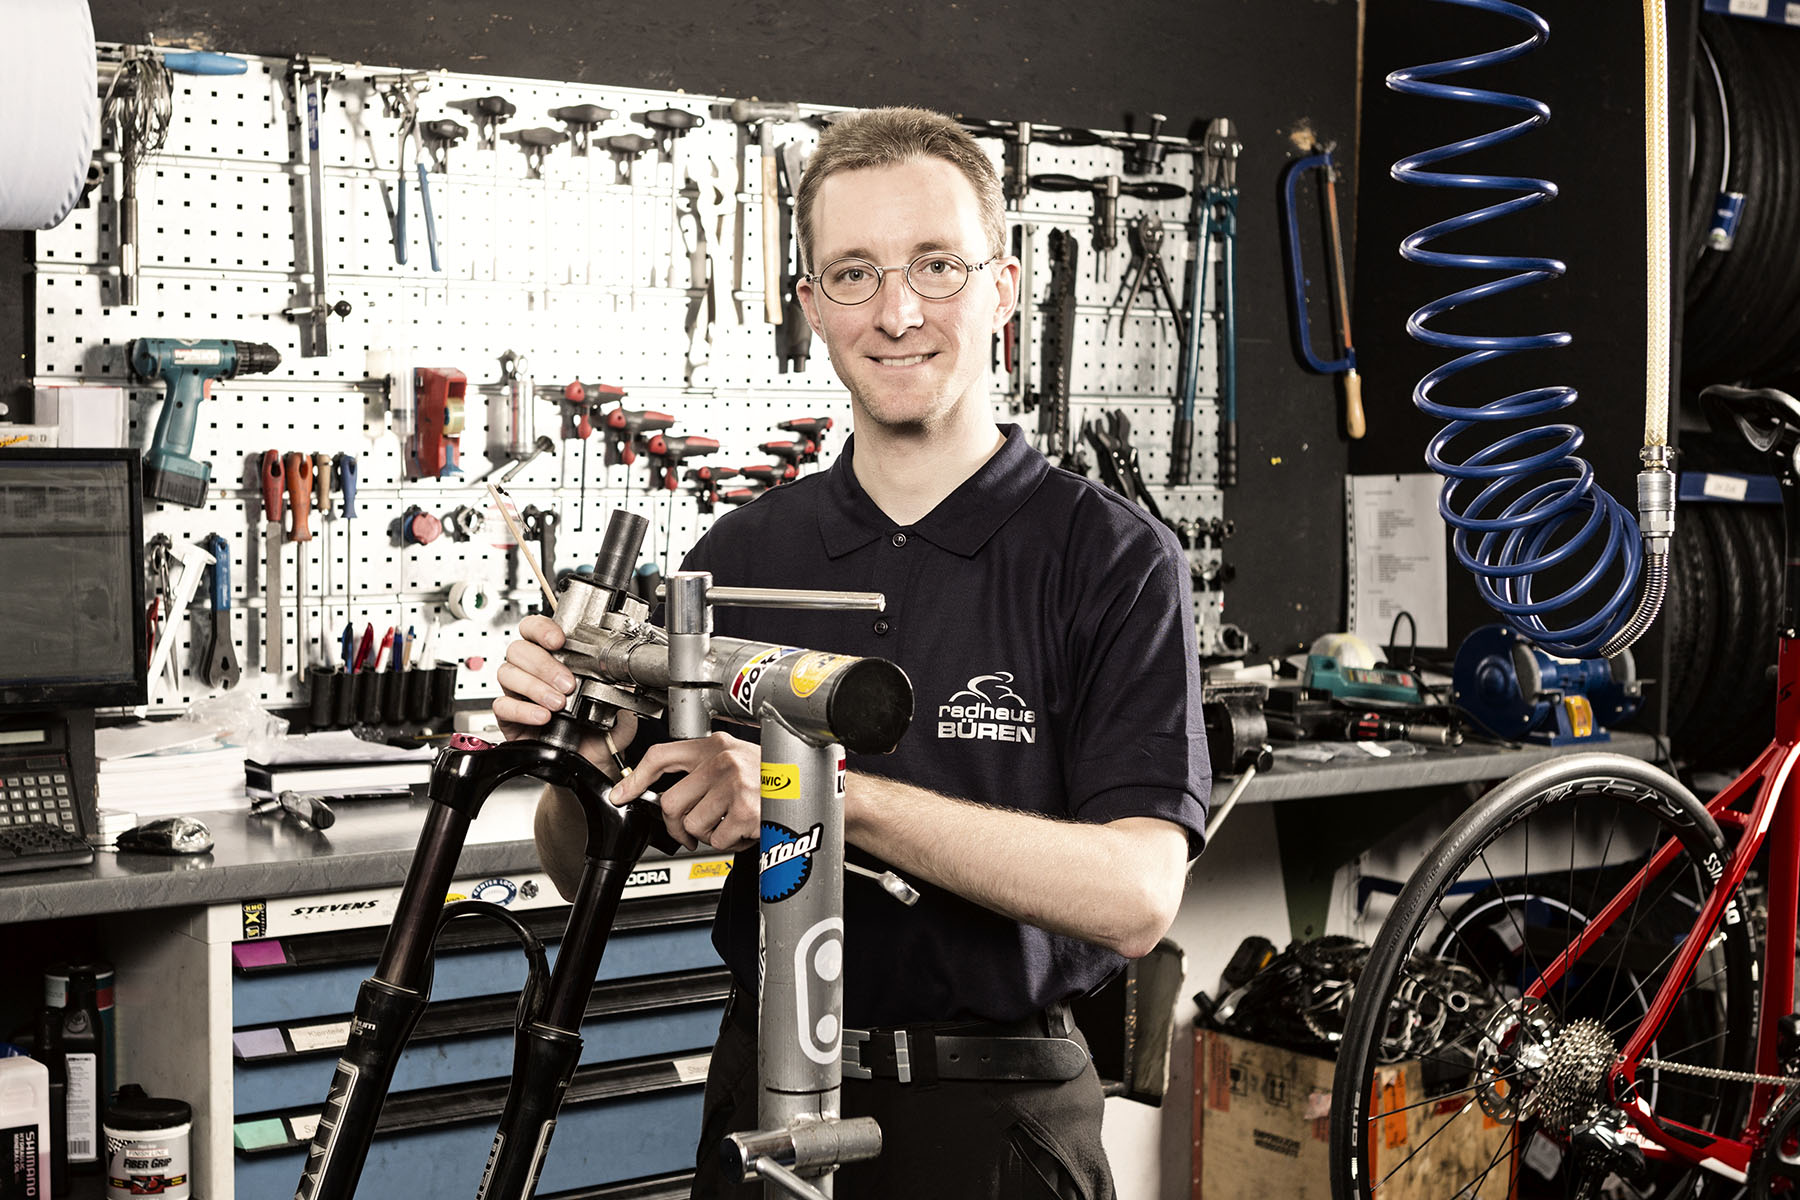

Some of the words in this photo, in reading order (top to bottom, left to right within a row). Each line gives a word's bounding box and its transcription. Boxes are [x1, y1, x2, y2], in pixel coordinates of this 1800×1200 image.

[740, 652, 777, 712] LOOK
[938, 702, 1036, 723] radhaus
[937, 718, 1036, 744] BÜREN
[761, 775, 781, 787] AVIC
[760, 826, 821, 875] kTool
[473, 880, 498, 896] CENTER
[499, 880, 516, 892] LOCK
[291, 899, 380, 916] STEVENS
[25, 1131, 36, 1197] SHIMANO
[123, 1158, 149, 1169] FIBER
[150, 1157, 172, 1169] GRIP
